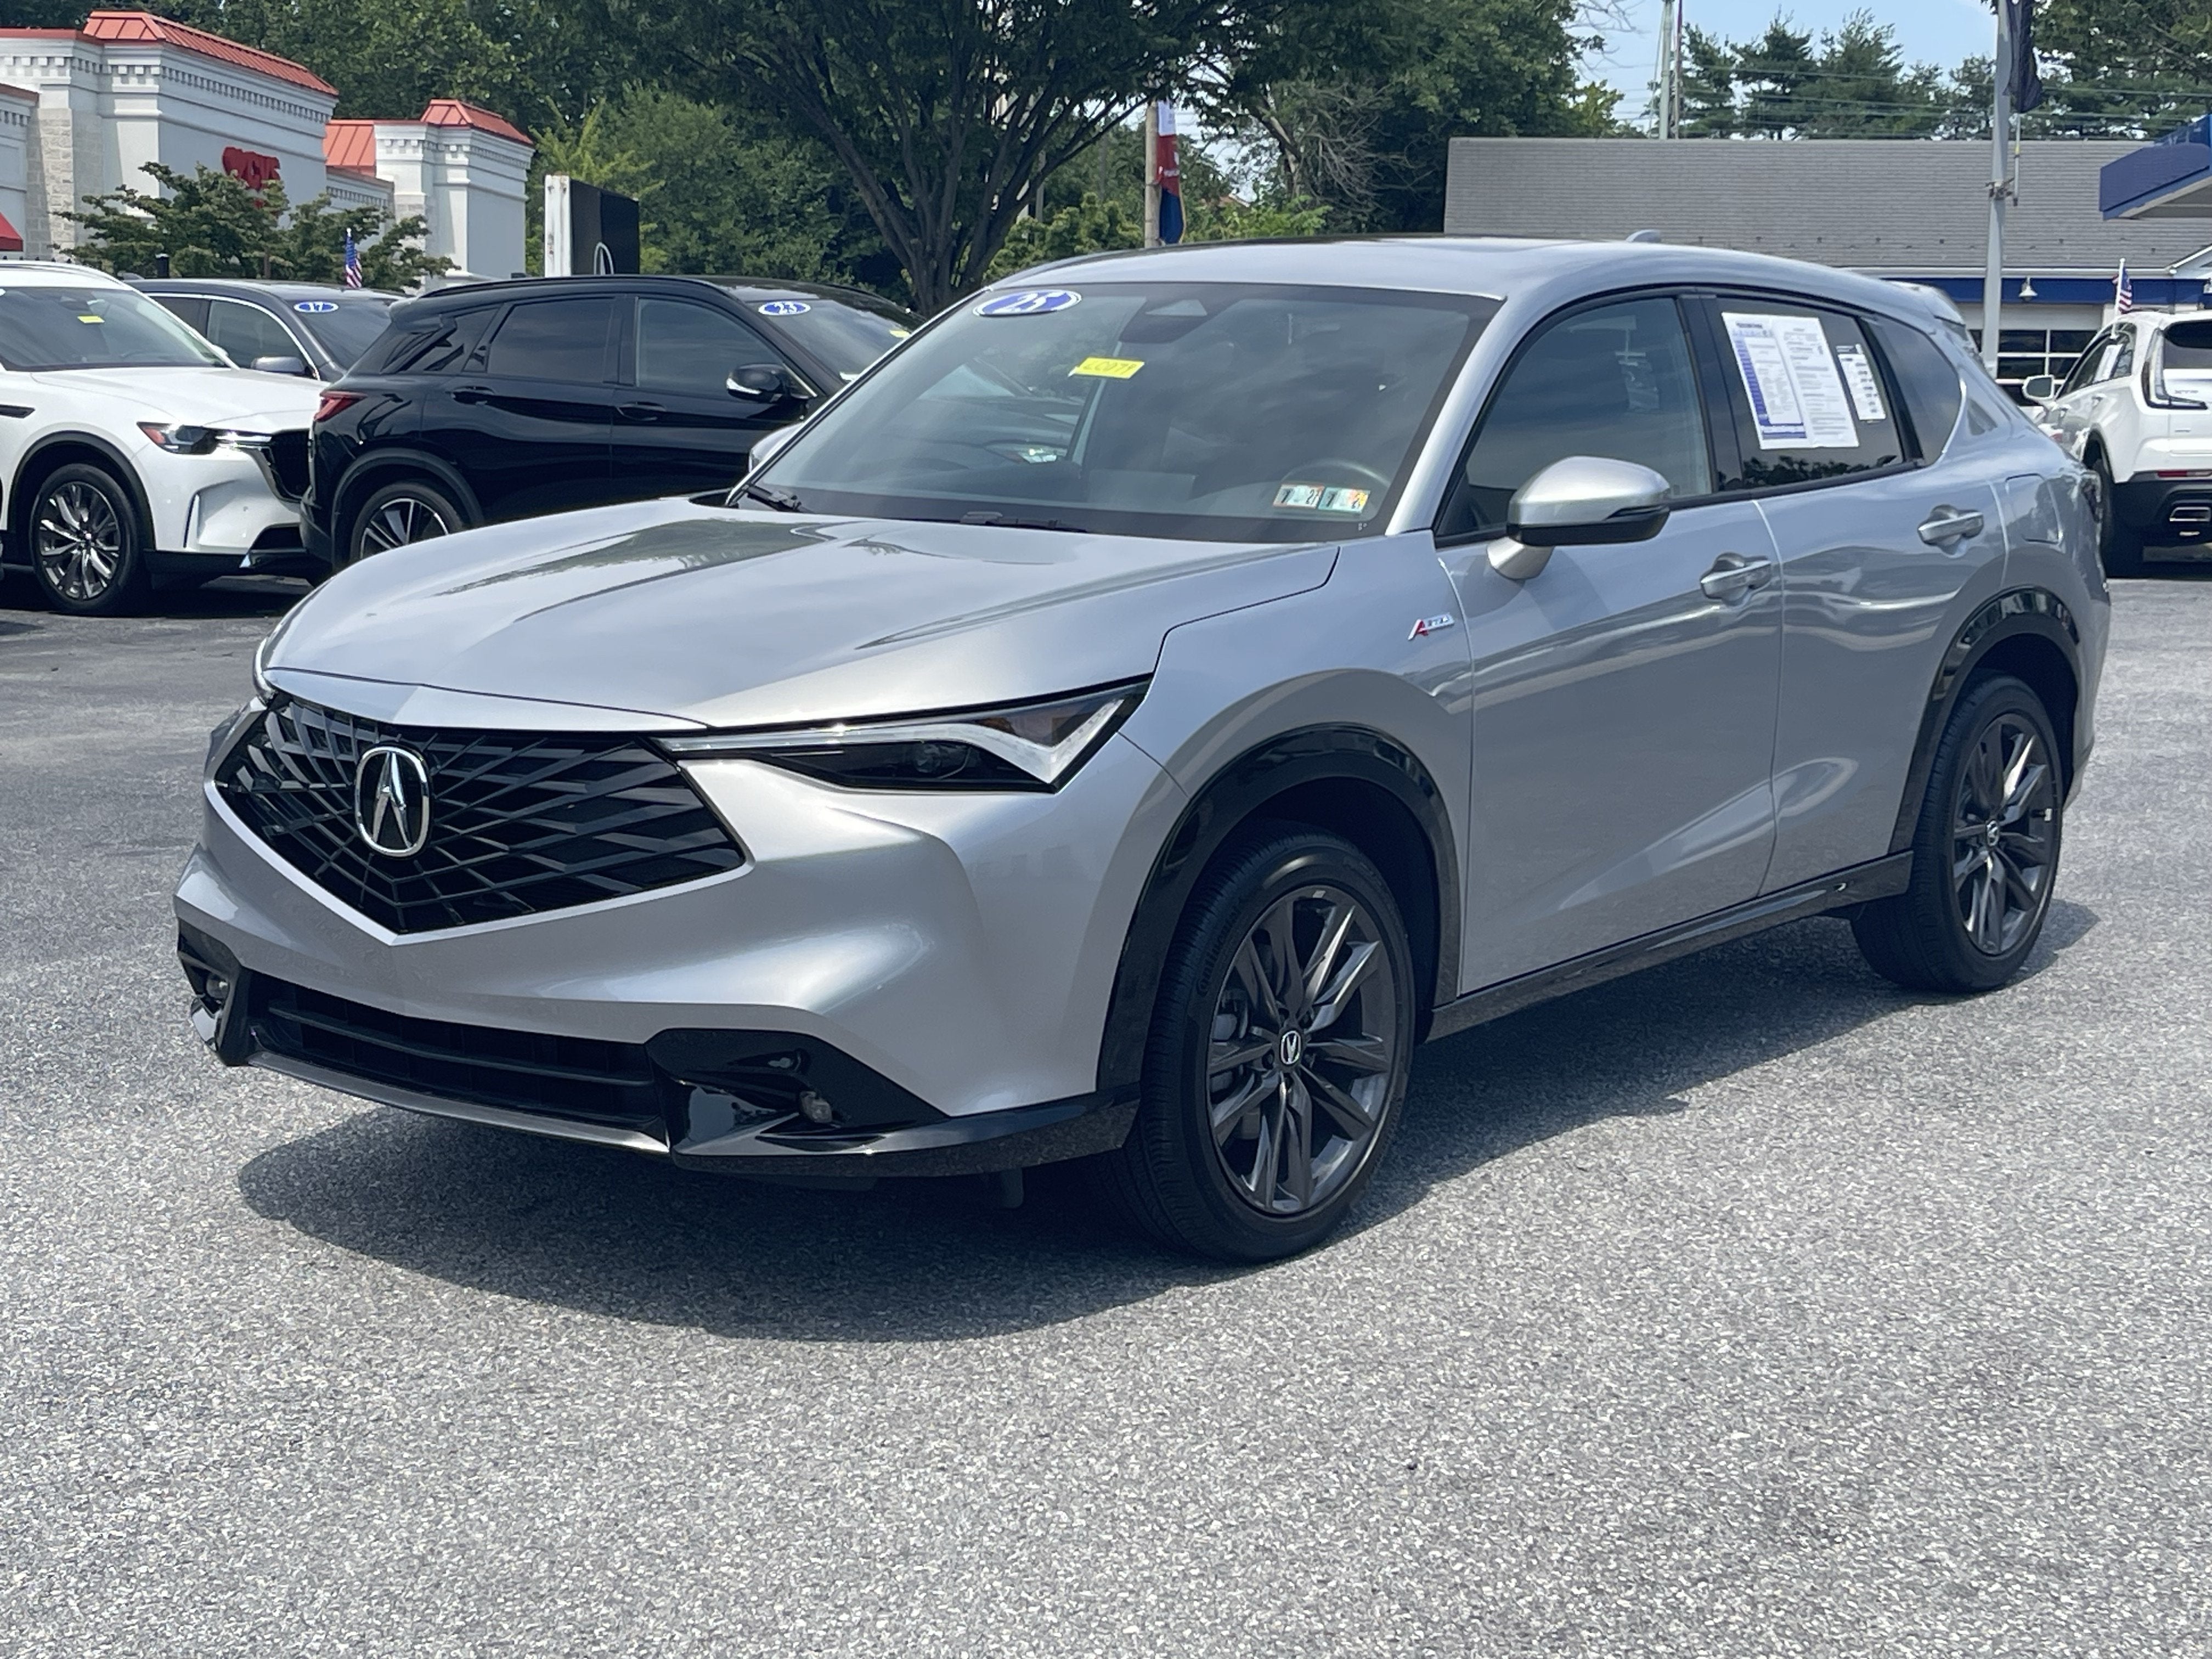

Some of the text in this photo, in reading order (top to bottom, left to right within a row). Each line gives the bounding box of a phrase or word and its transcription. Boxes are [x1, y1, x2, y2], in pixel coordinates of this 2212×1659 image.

[308, 301, 324, 312] 17
[774, 301, 798, 315] 23
[992, 291, 1068, 314] 25
